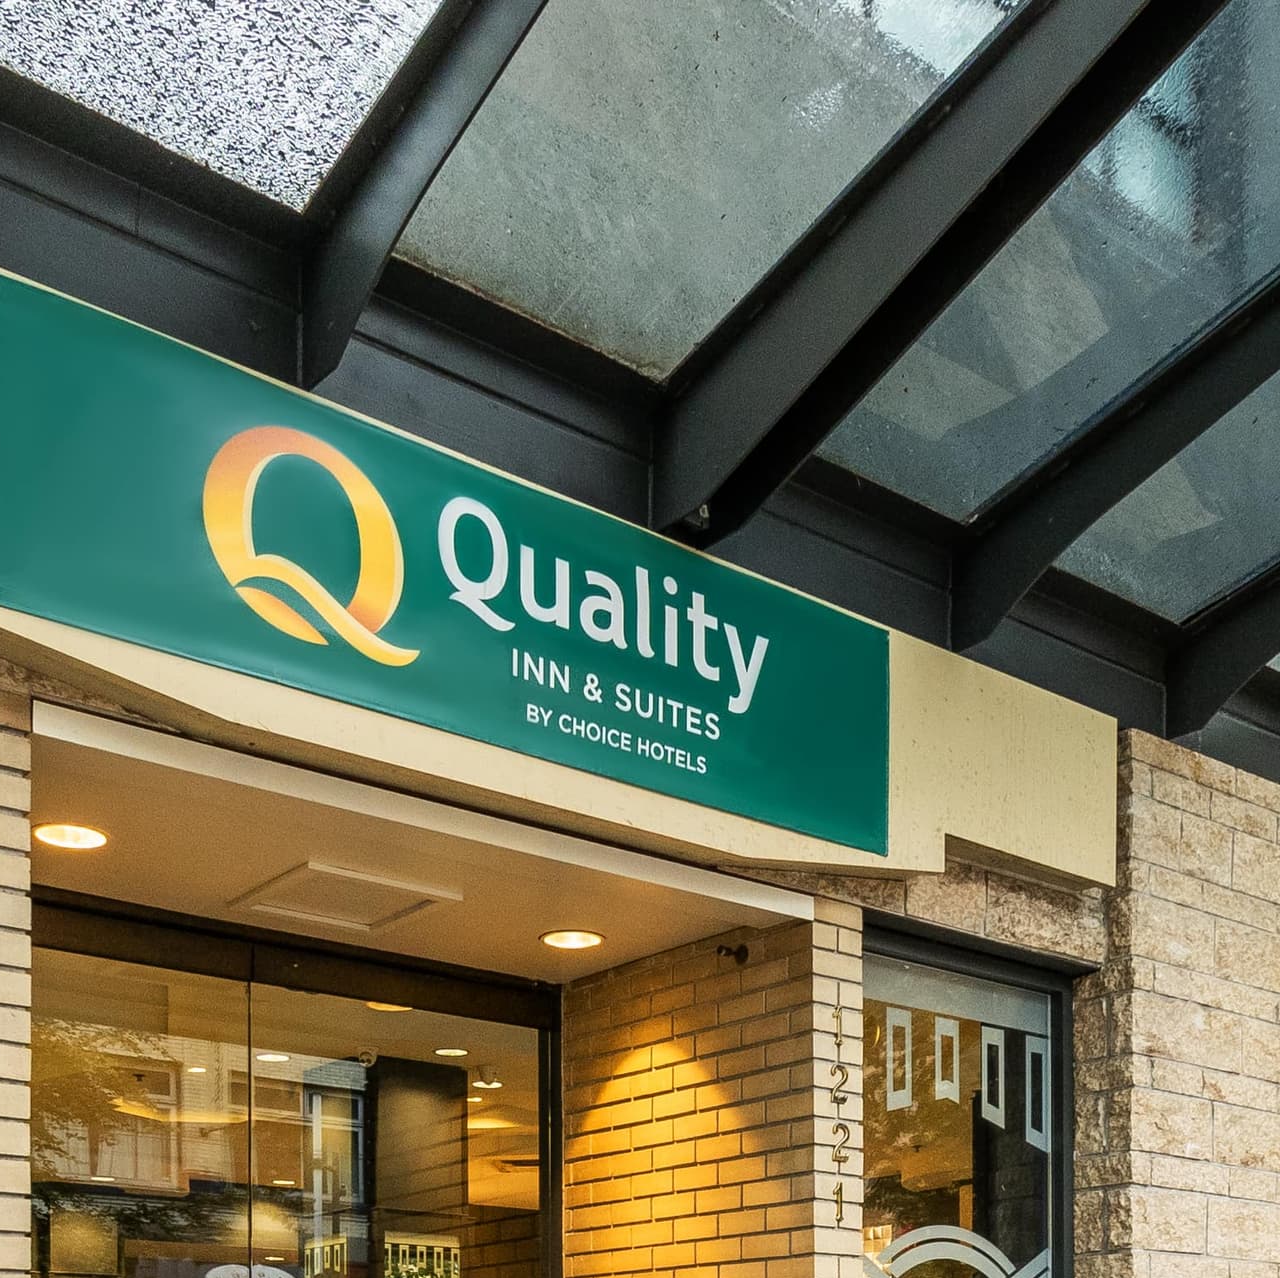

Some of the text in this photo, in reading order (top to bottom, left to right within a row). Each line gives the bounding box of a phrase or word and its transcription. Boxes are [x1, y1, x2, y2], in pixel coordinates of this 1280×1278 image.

[202, 426, 419, 667] Q
[438, 496, 770, 715] Quality
[512, 648, 720, 741] INN & SUITES
[526, 703, 707, 774] BY CHOICE HOTELS
